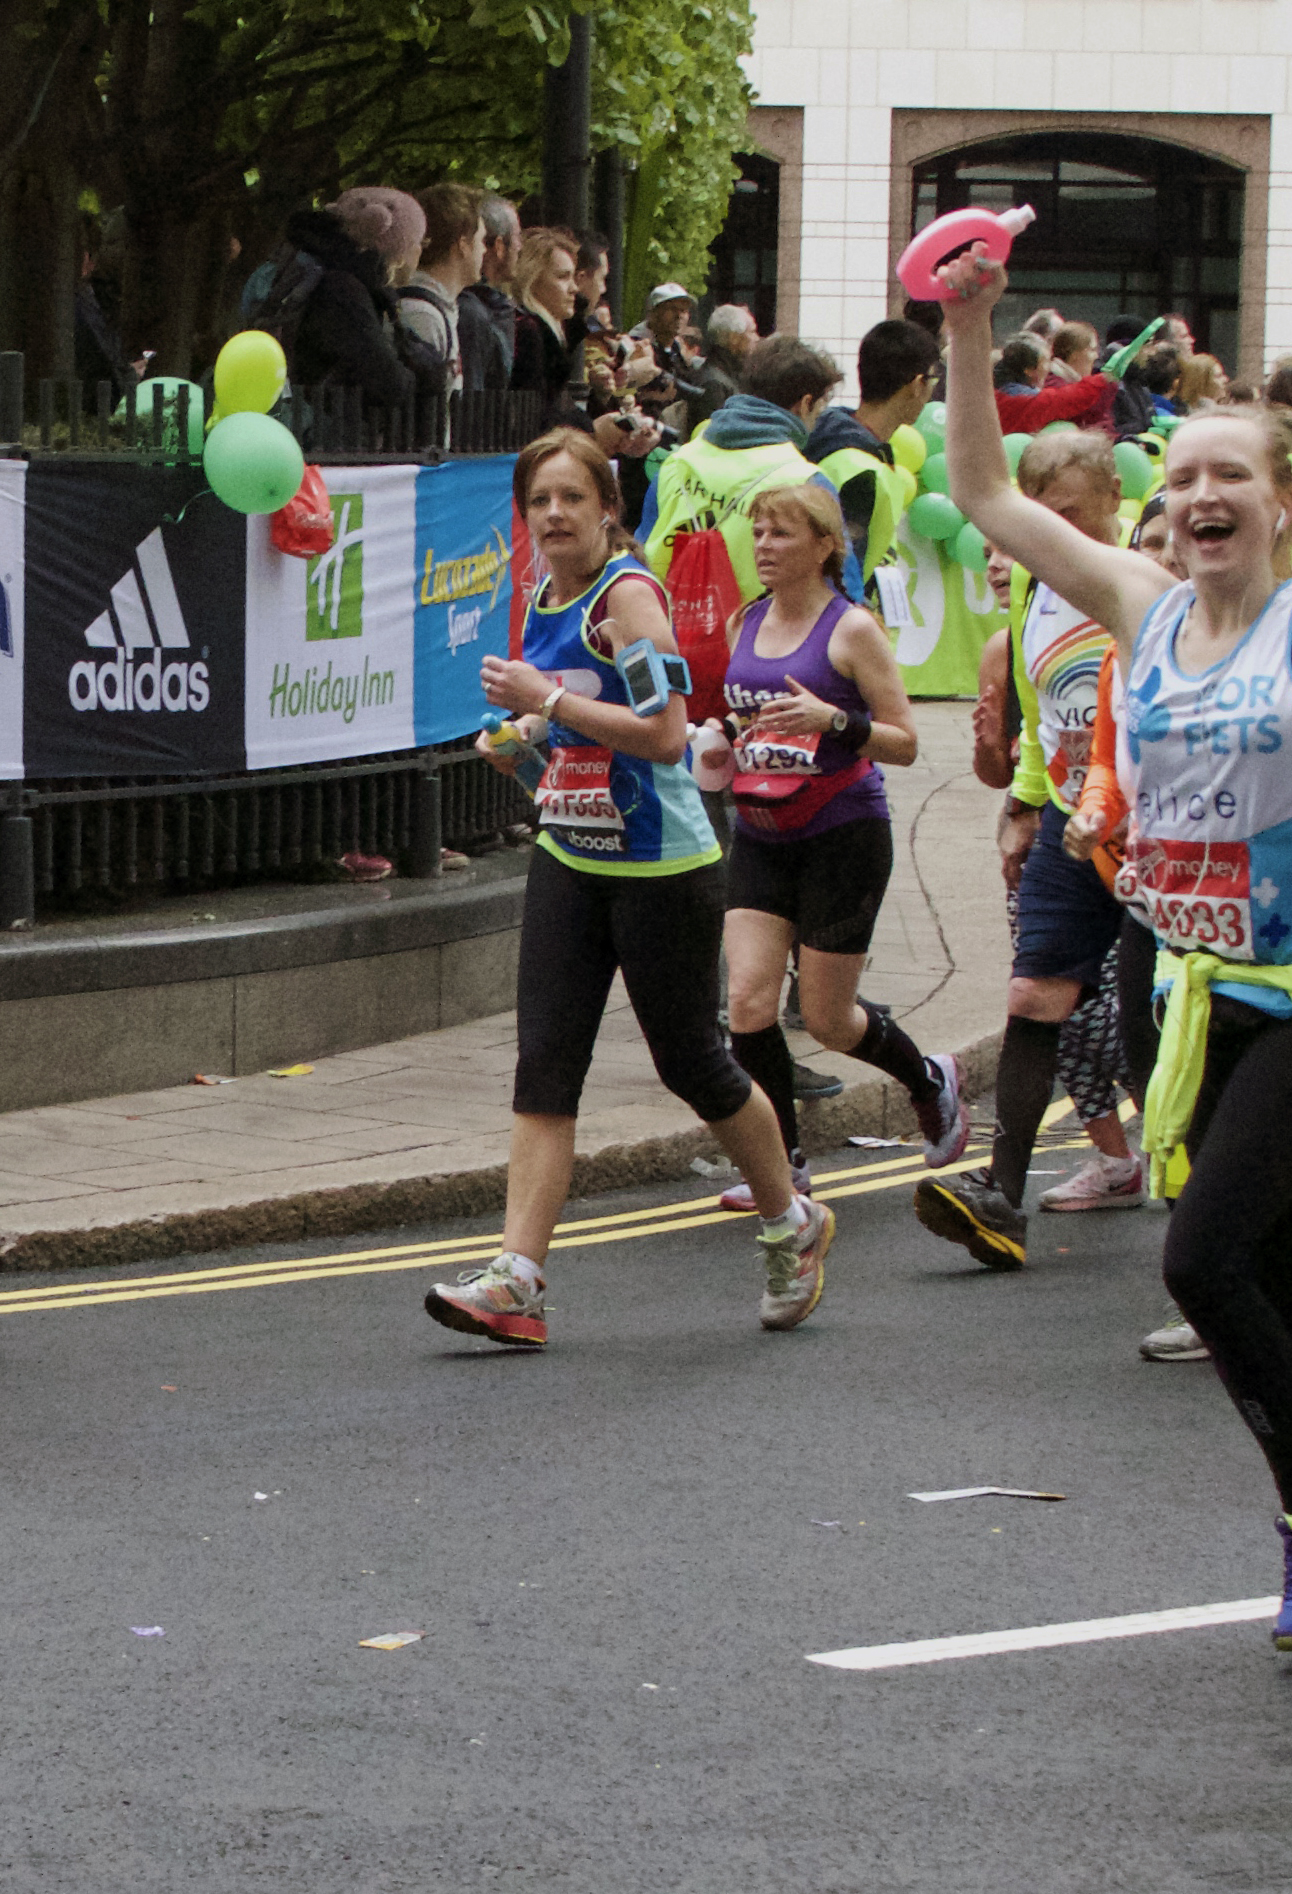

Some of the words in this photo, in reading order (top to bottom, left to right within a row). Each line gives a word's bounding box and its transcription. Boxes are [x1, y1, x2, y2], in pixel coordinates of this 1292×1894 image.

[69, 646, 210, 712] adidas
[269, 662, 358, 724] Holiday
[362, 655, 394, 707] Inn
[569, 831, 623, 851] boost
[1169, 859, 1241, 884] money
